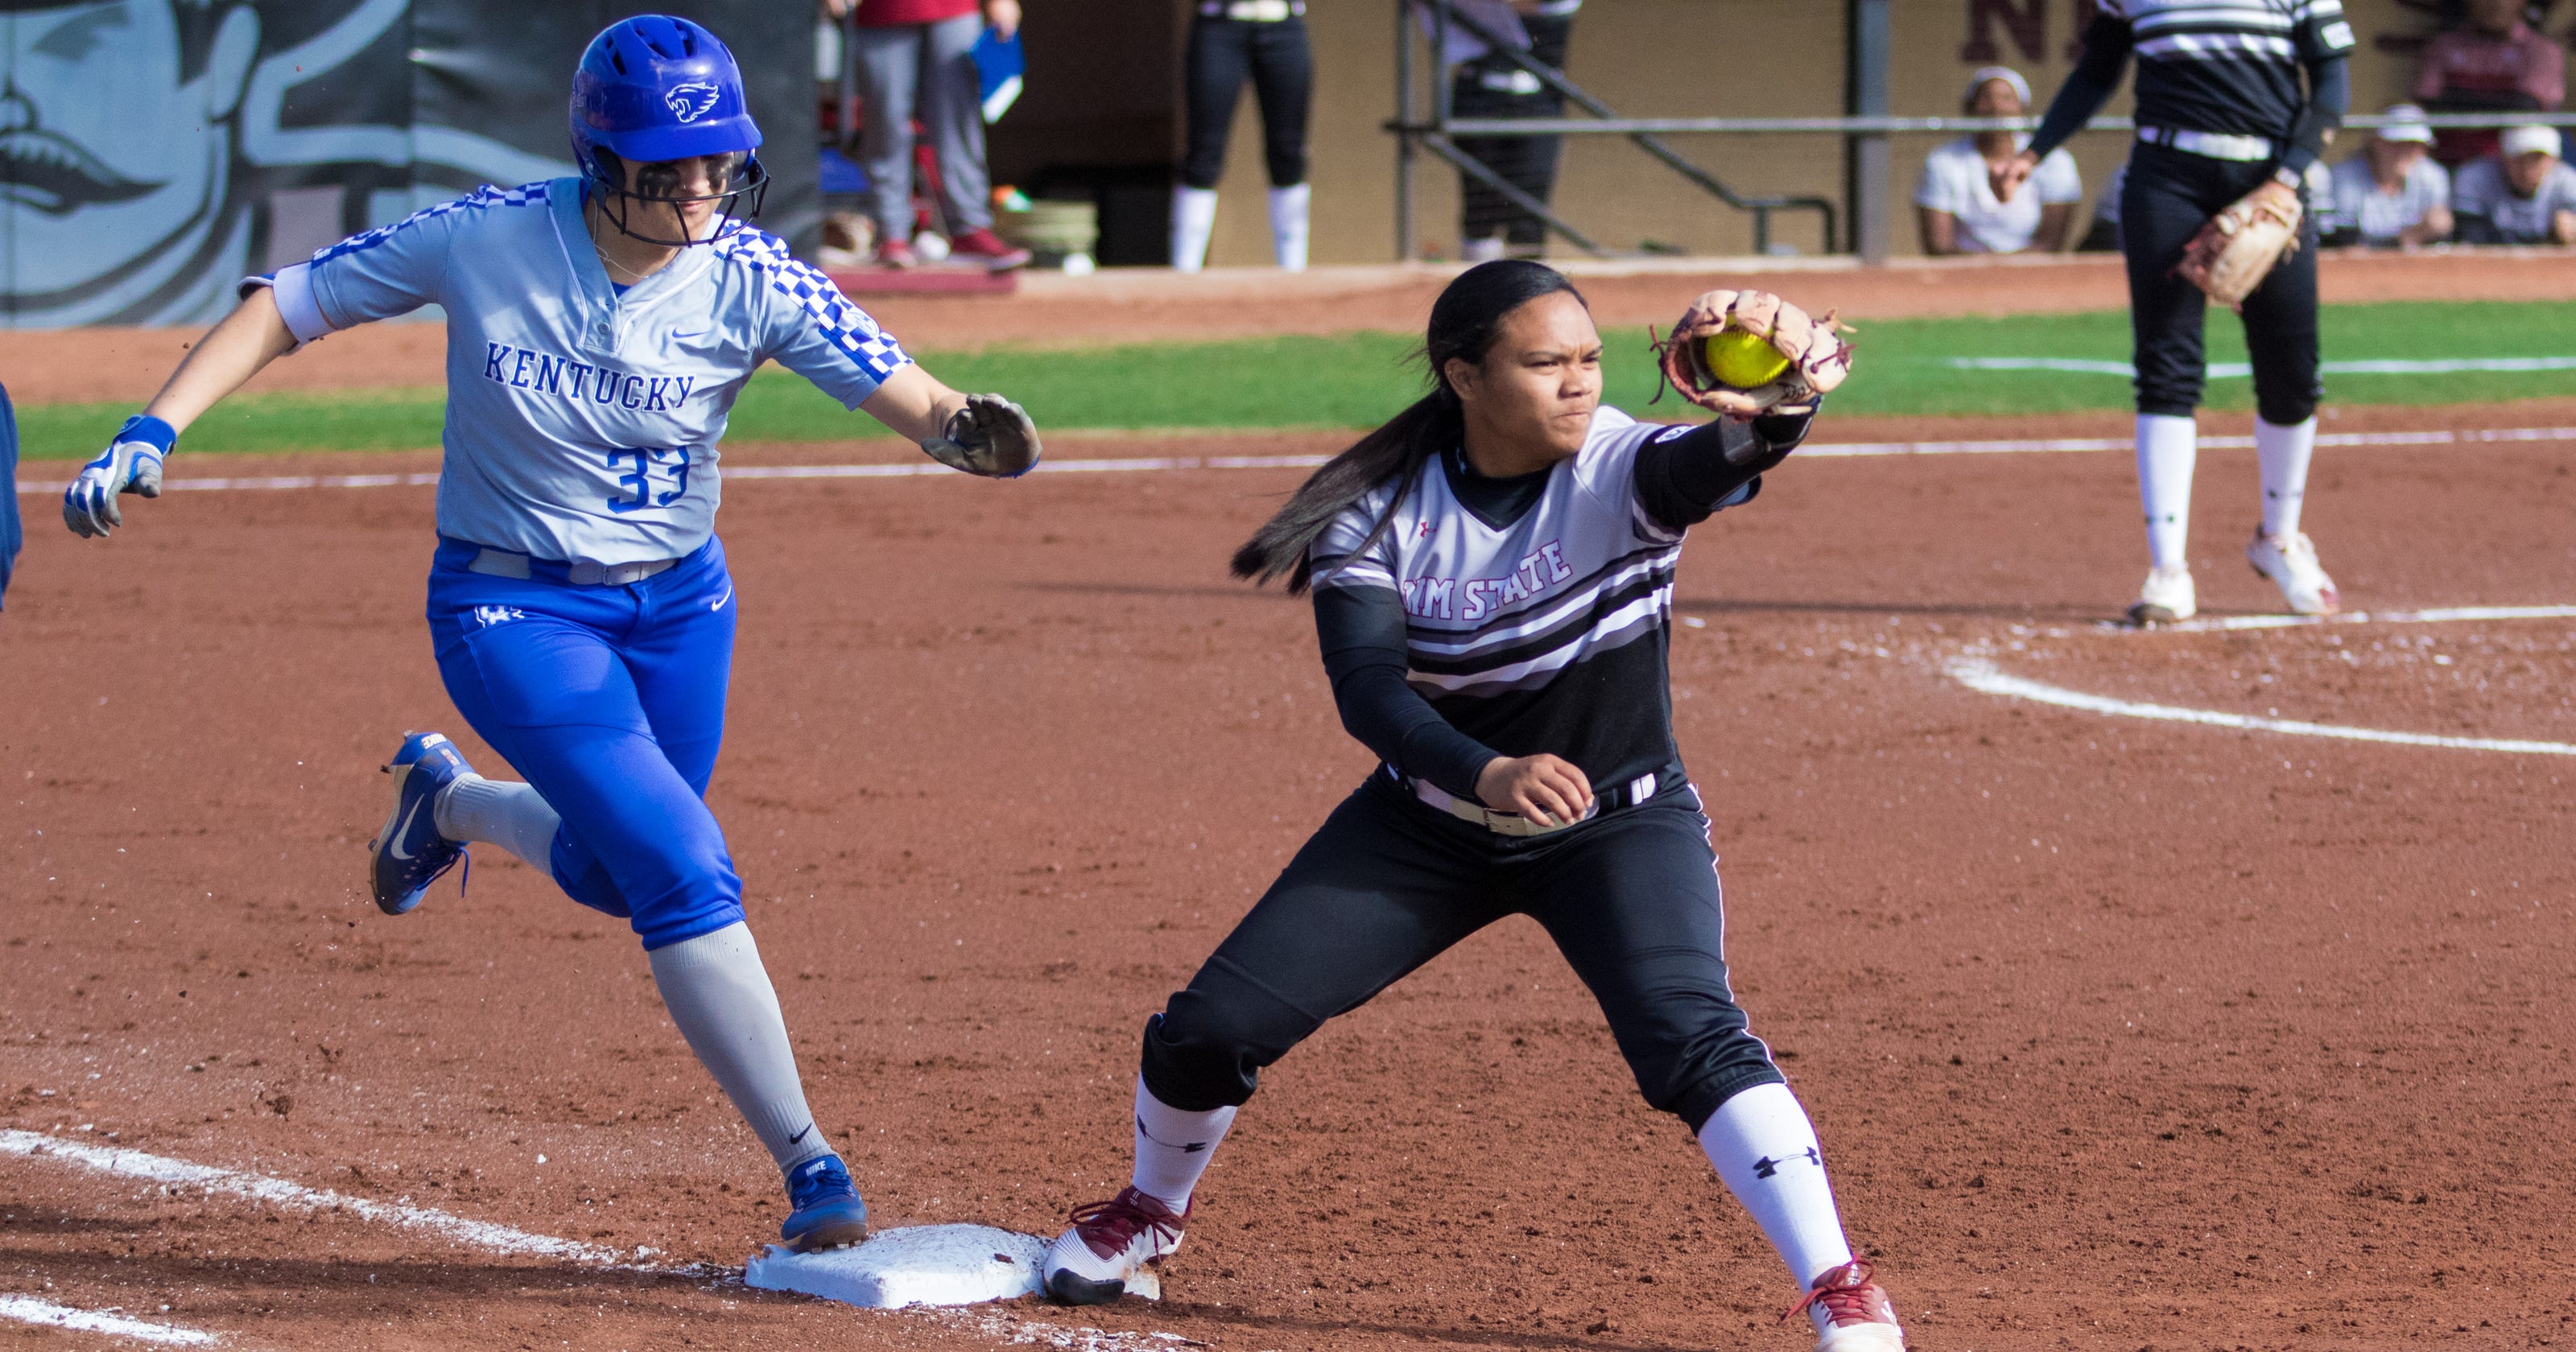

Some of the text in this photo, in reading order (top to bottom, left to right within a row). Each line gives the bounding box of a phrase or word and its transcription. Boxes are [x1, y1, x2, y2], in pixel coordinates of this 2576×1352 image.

[483, 340, 696, 413] KENTUCKY
[607, 445, 691, 514] 33
[1462, 538, 1574, 621] STATE
[805, 1160, 828, 1177] NIKE
